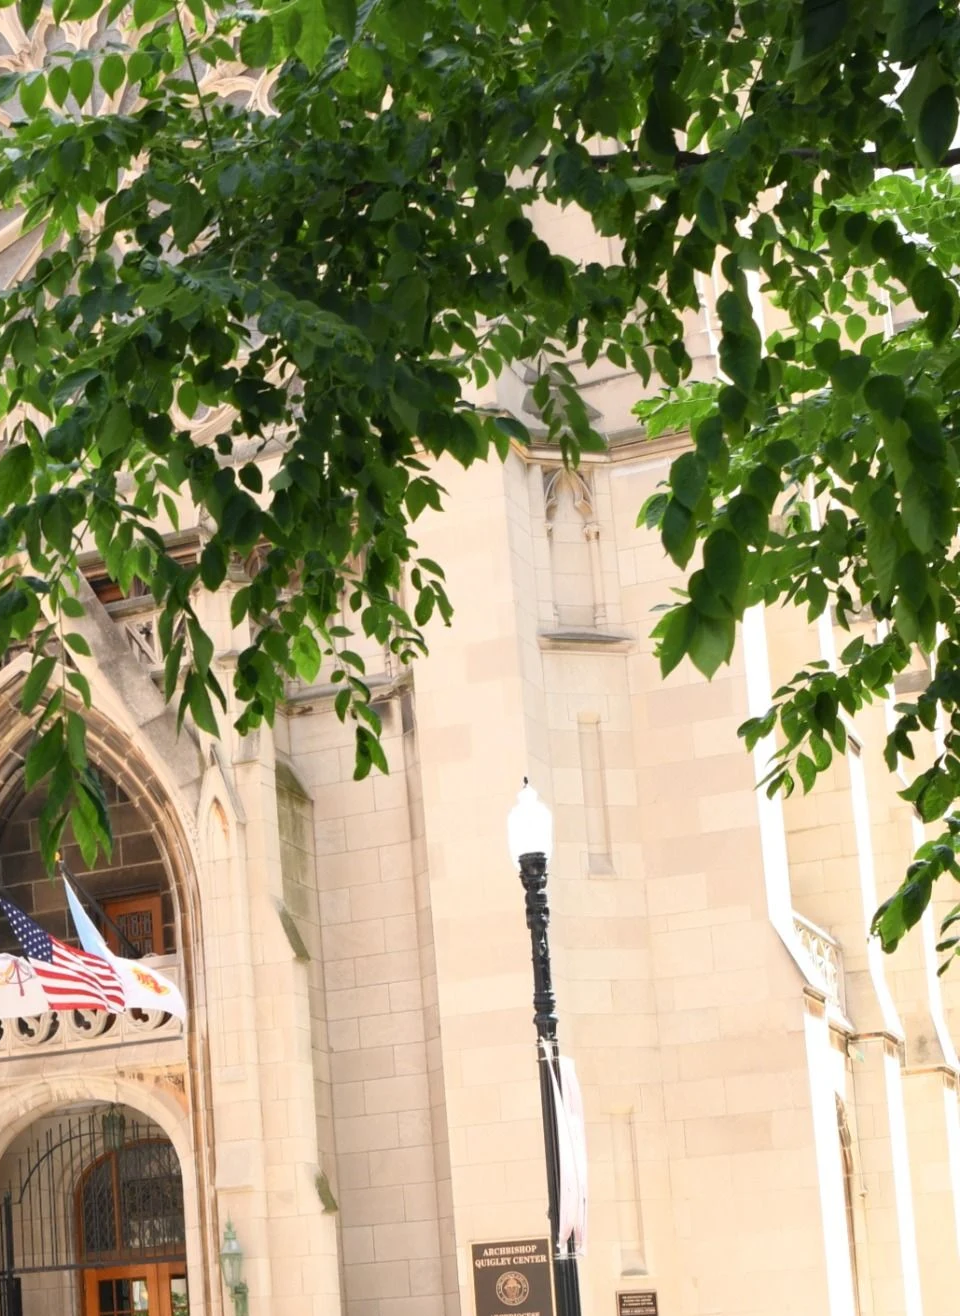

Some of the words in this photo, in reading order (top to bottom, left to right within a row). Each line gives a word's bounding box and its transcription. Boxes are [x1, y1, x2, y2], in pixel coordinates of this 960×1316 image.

[482, 1245, 537, 1257] ARCHBISHOP
[474, 1257, 512, 1269] QUIGLEY
[512, 1254, 548, 1265] CENTER
